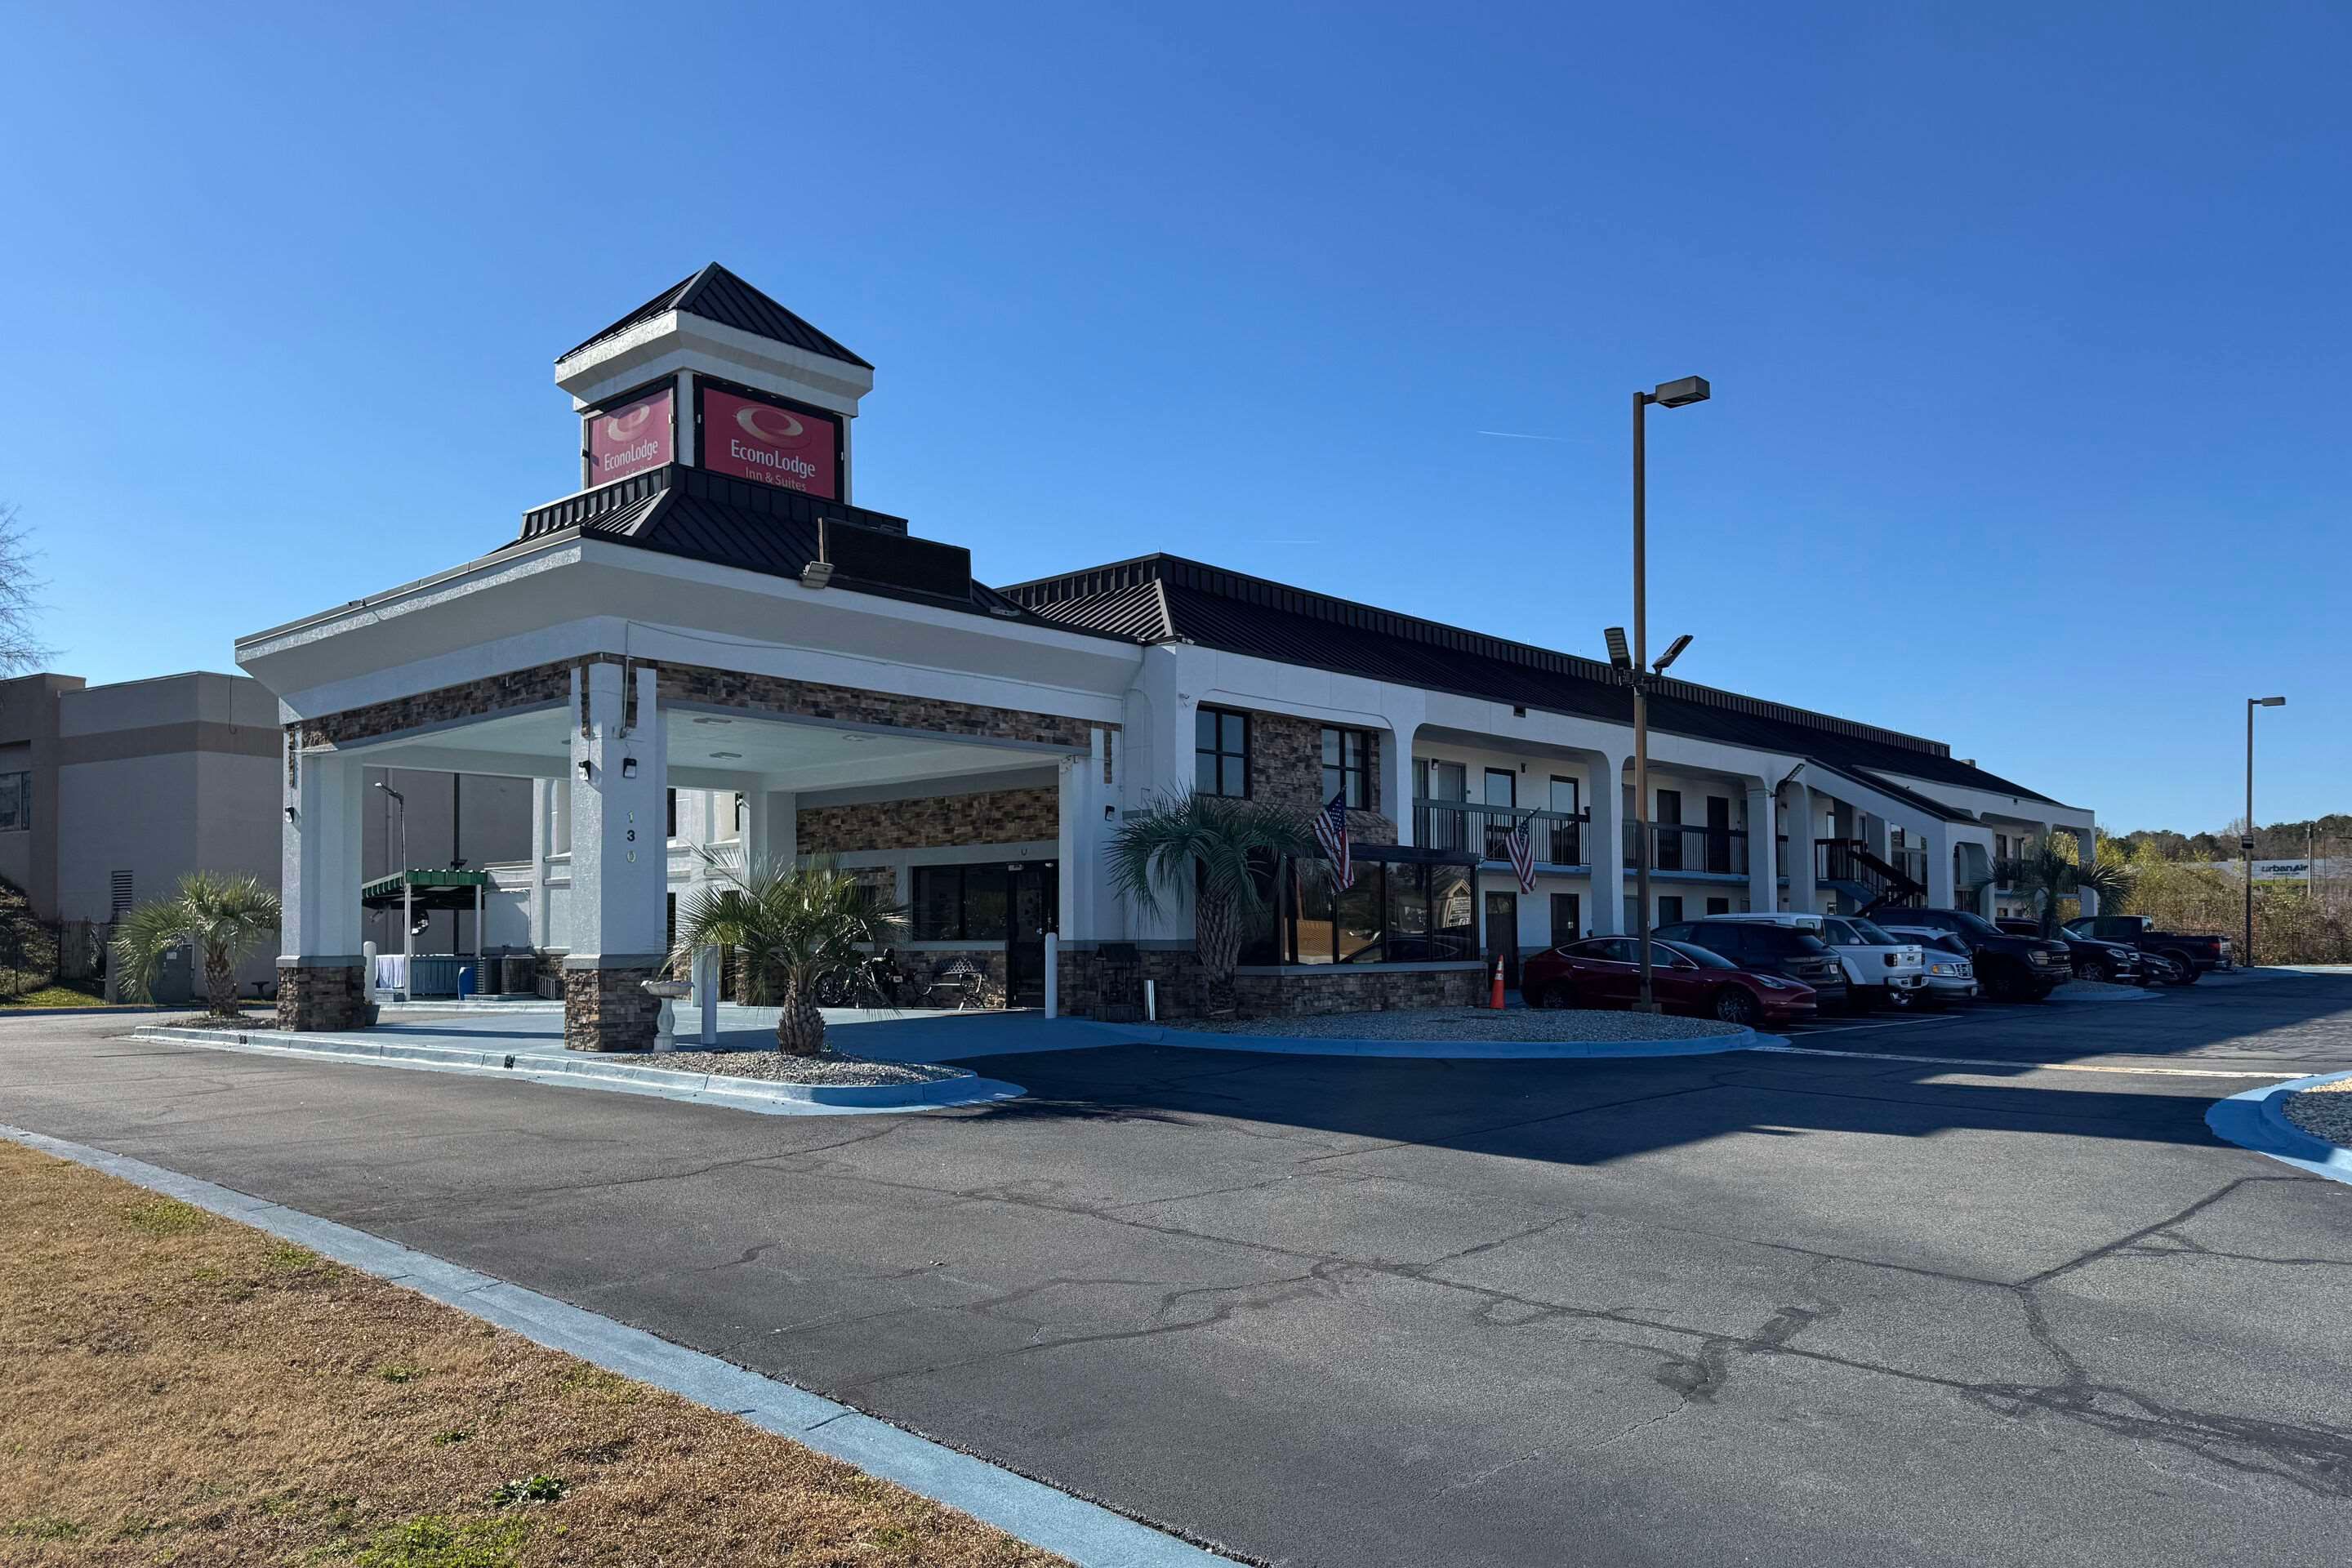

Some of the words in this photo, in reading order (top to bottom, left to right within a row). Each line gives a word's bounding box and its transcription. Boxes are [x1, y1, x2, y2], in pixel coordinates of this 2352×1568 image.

[604, 439, 658, 471] EconoLodge
[732, 439, 816, 479] EconoLodge
[745, 466, 763, 481] Inn
[765, 472, 772, 483] &
[775, 474, 806, 491] Suites
